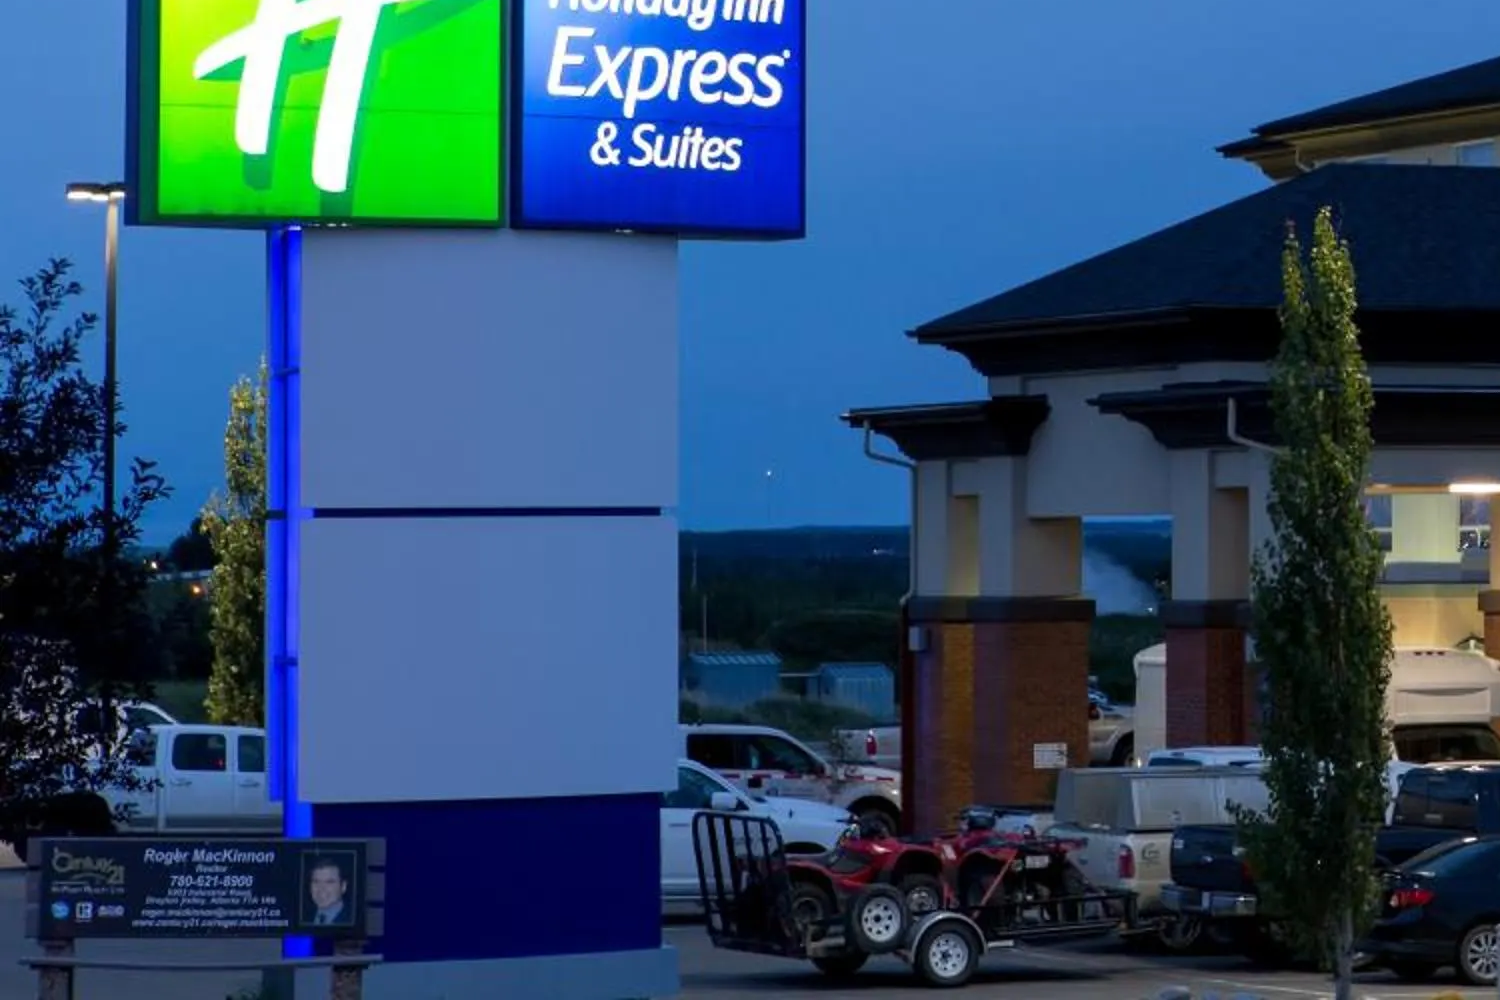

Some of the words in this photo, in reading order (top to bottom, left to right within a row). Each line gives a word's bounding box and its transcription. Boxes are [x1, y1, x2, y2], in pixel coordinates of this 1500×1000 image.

[546, 26, 786, 119] Express
[589, 121, 621, 166] &
[628, 122, 743, 172] Suites
[143, 848, 189, 865] Roger
[191, 848, 275, 864] MacKinnon
